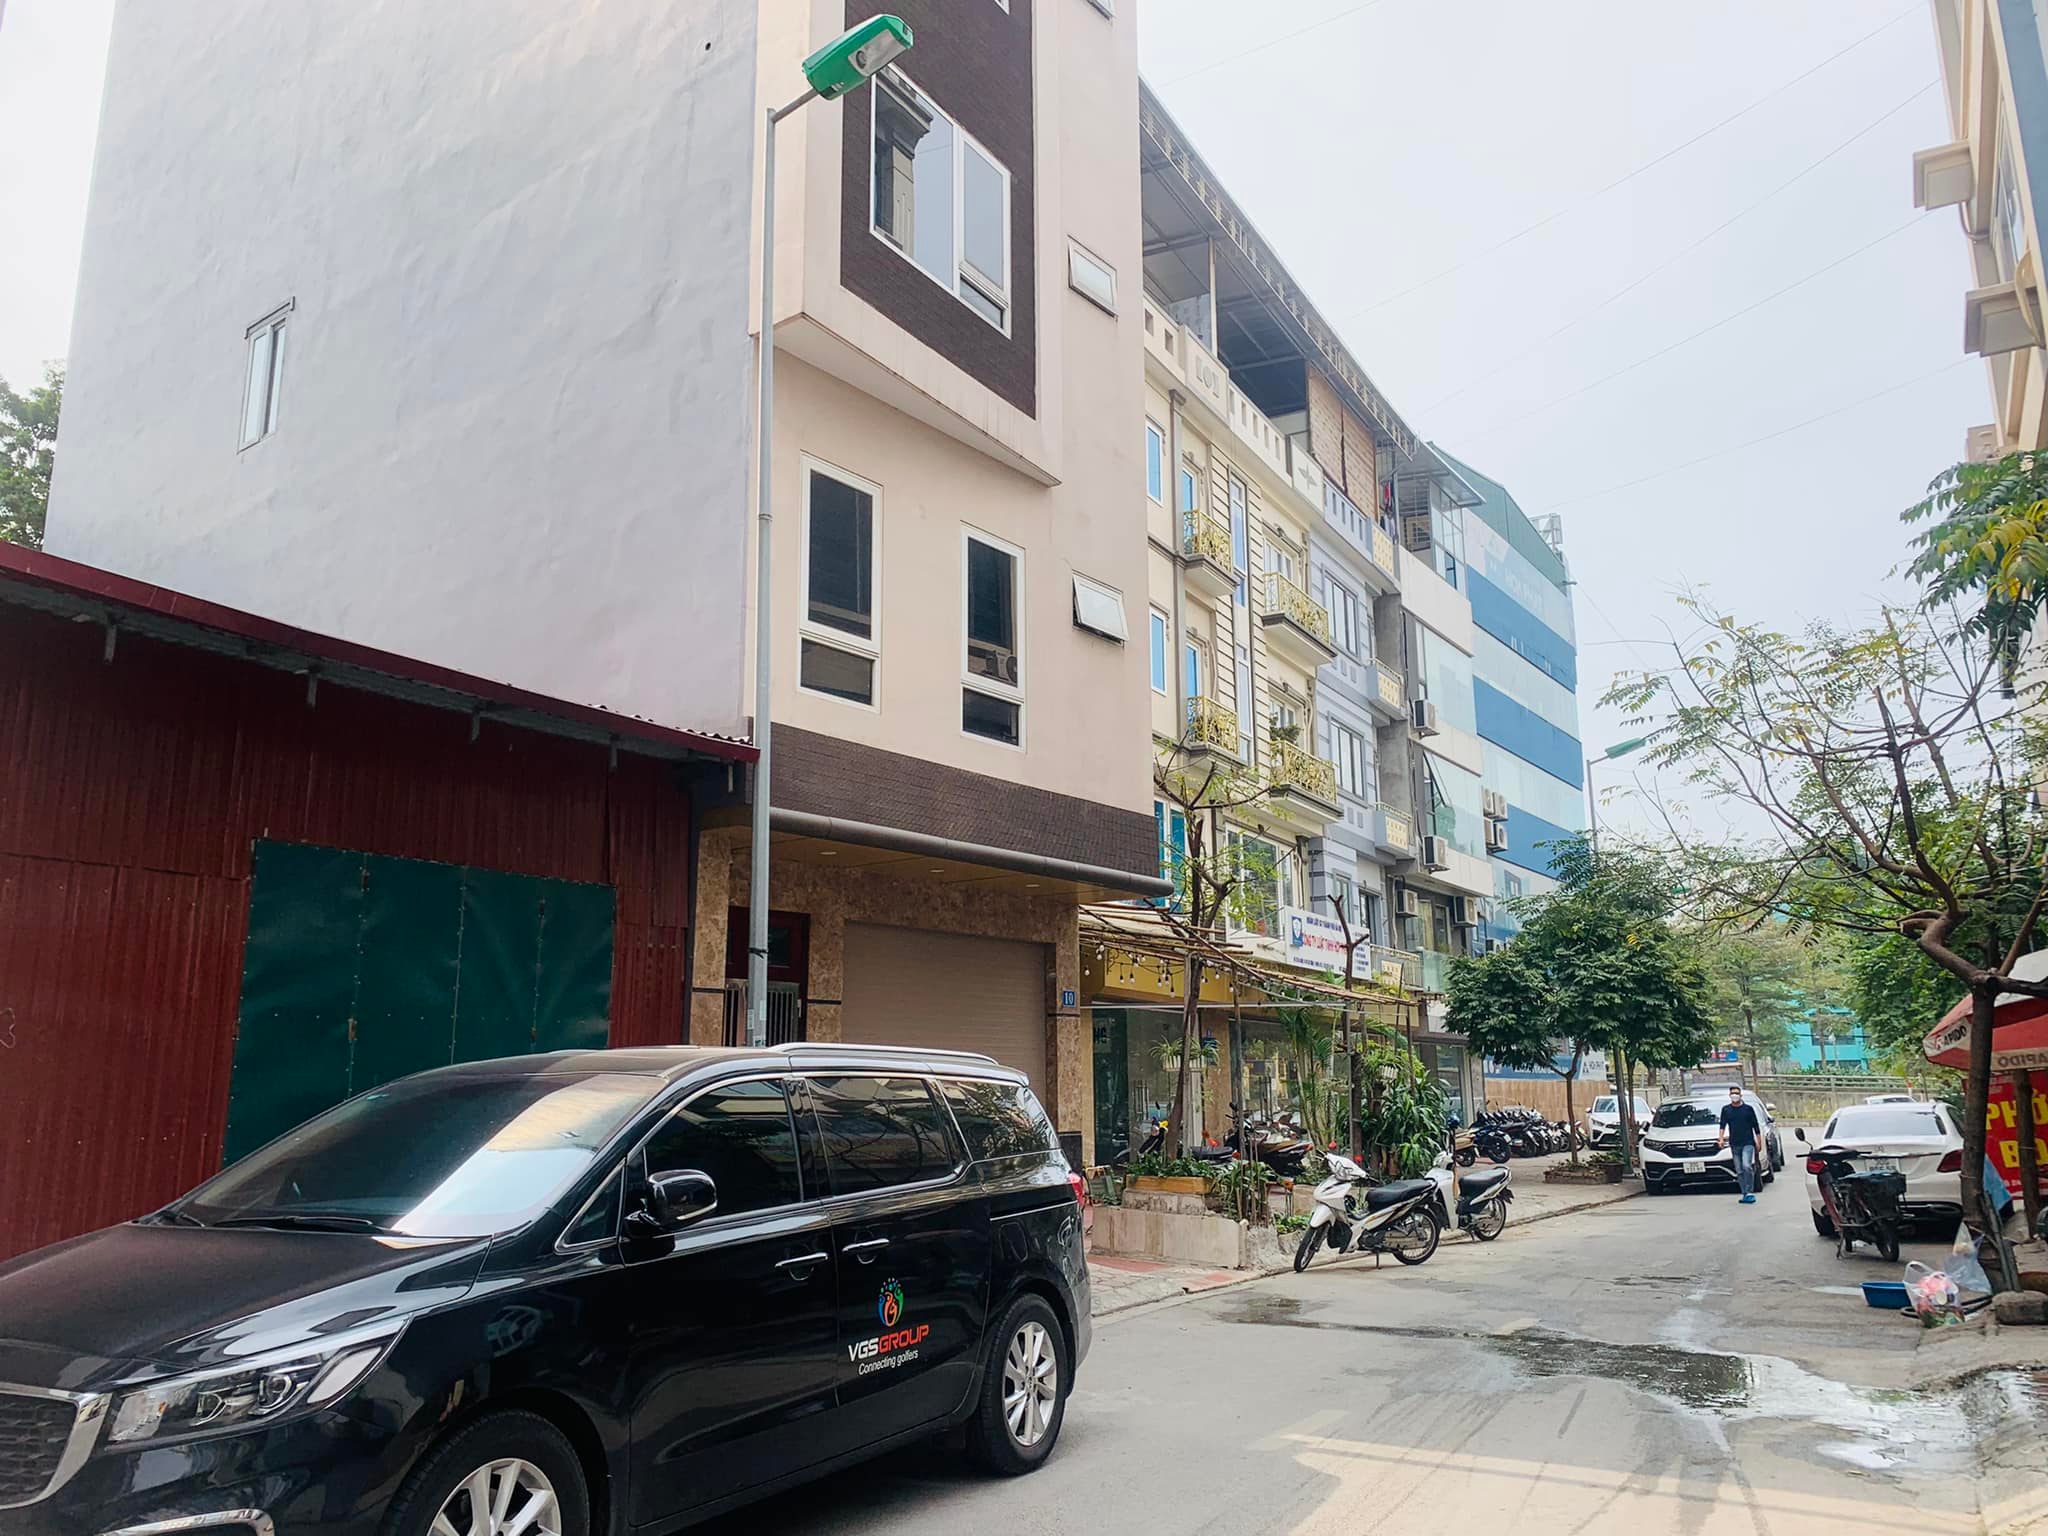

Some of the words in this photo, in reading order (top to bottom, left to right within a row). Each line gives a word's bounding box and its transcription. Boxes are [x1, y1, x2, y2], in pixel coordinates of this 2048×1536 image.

[1064, 991, 1074, 1005] 10
[1934, 1025, 1967, 1050] RAPIDO
[848, 1324, 929, 1362] VGSGROUP
[858, 1355, 896, 1375] Connecting
[896, 1349, 919, 1366] golfers
